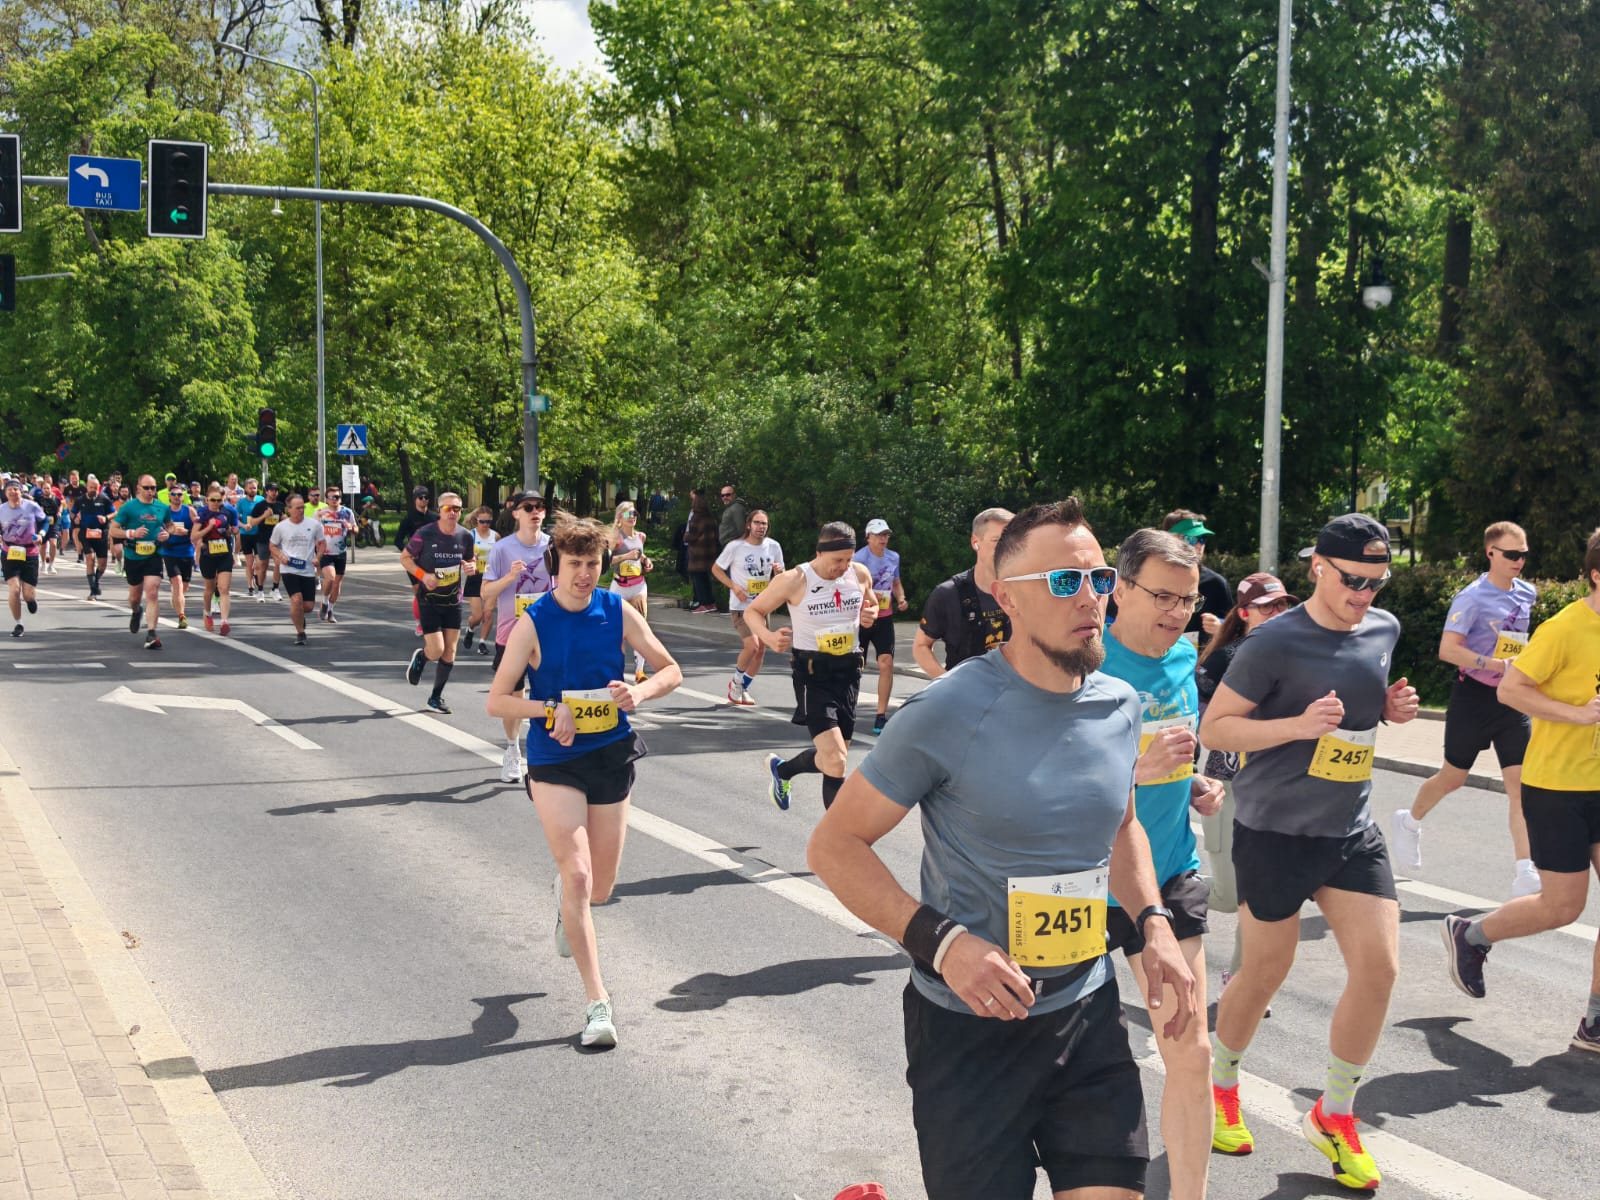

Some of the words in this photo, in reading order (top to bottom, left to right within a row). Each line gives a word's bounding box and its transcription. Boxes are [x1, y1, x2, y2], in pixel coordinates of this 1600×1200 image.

[95, 198, 113, 206] TAXI
[826, 636, 847, 648] 1841
[1502, 643, 1522, 654] 2365
[575, 704, 610, 719] 2466
[1329, 748, 1369, 765] 2457
[1034, 905, 1091, 936] 2451
